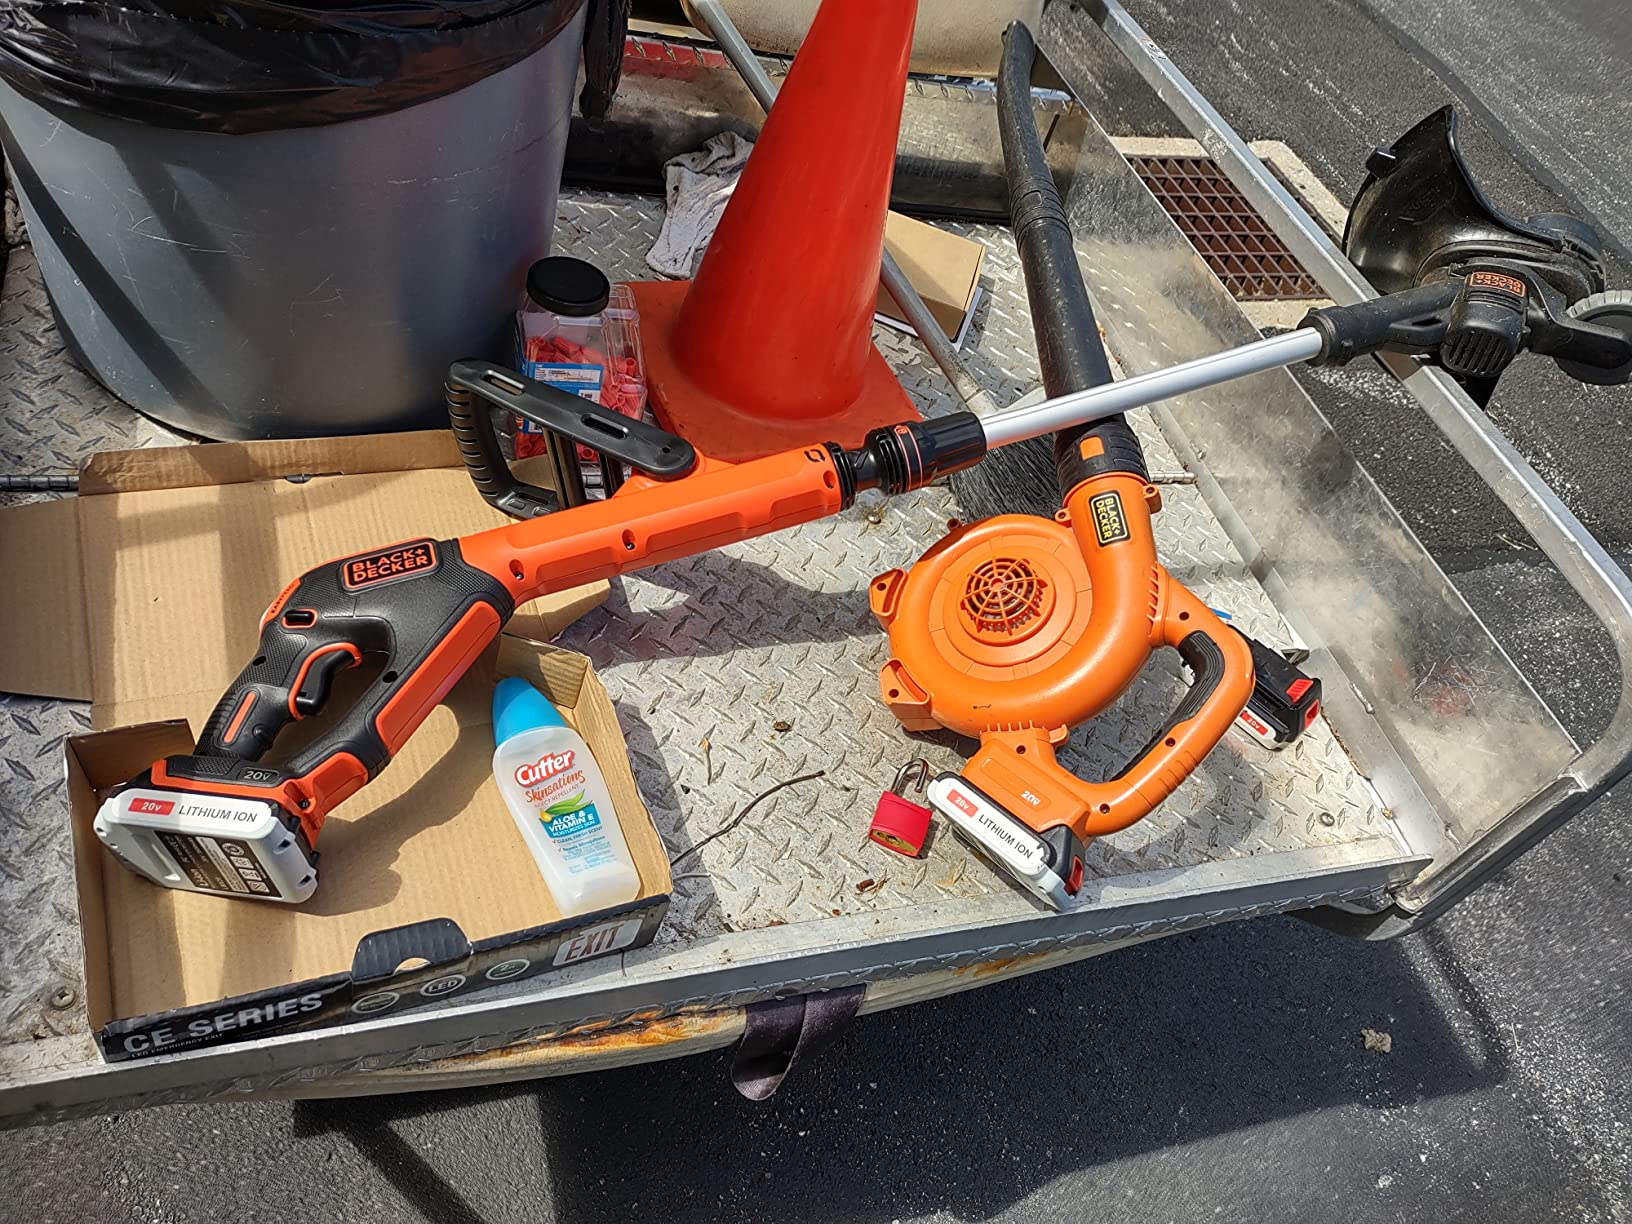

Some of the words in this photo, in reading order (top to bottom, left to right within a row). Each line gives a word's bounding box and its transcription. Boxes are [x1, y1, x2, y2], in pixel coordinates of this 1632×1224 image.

[1475, 279, 1520, 293] BLACK+
[1476, 273, 1521, 287] DECKER
[1096, 501, 1112, 539] DECKER
[1105, 498, 1120, 535] BLACK+
[352, 548, 425, 572] BLACK+
[353, 555, 428, 582] DECKER
[515, 750, 573, 786] Cutter
[525, 770, 586, 803] Skinsations
[178, 805, 232, 820] LITHIUM
[233, 810, 258, 823] ION
[549, 816, 586, 832] VITAMIN
[587, 813, 595, 821] E
[552, 813, 576, 826] ALOE
[578, 810, 586, 818] &
[978, 814, 1016, 846] LITHIUM
[1015, 841, 1034, 859] ION
[565, 924, 624, 961] EXIT
[428, 979, 458, 993] LED
[124, 1028, 176, 1053] CE
[188, 993, 323, 1038] SERIES
